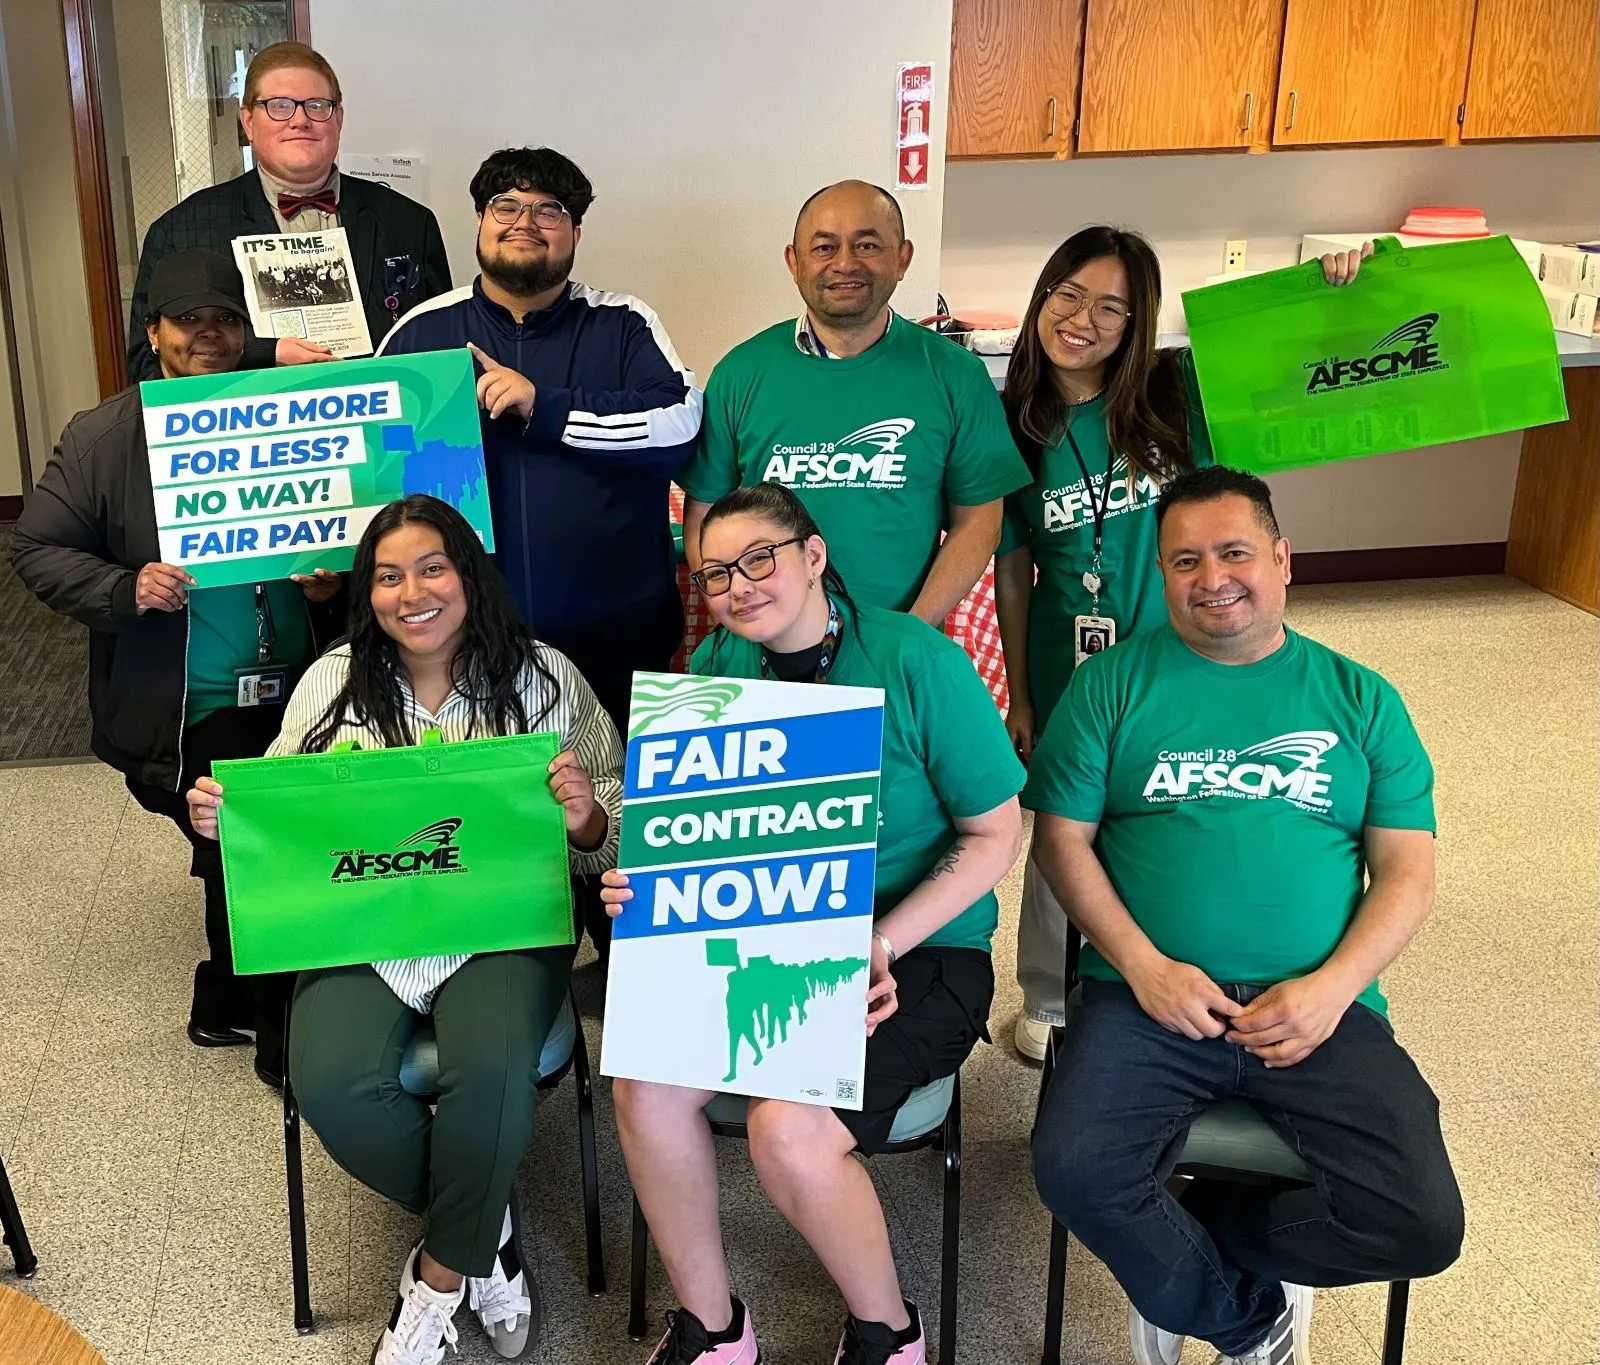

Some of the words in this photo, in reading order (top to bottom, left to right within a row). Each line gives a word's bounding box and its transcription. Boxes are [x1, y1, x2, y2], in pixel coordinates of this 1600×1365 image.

[904, 75, 928, 88] FIRE
[279, 236, 324, 250] TIME
[301, 246, 335, 255] bargain!
[1319, 383, 1356, 394] WASHINGTON
[1357, 375, 1391, 386] FEDERATION
[1400, 370, 1416, 378] STATE
[1417, 363, 1450, 374] EMPLOYEES
[164, 402, 278, 437] DOING
[288, 390, 388, 424] MORE
[170, 448, 240, 478] FOR
[250, 436, 350, 468] LESS?
[772, 443, 816, 454] Council
[820, 442, 835, 454] 28
[802, 481, 837, 489] Federation
[866, 482, 904, 490] Employees
[1042, 478, 1086, 500] Council
[175, 490, 227, 518] NO
[238, 478, 331, 509] WAY!
[1130, 503, 1148, 512] State
[180, 528, 259, 559] FAIR
[269, 516, 347, 548] PAY!
[637, 728, 788, 789] FAIR
[1158, 748, 1214, 762] Council
[1217, 749, 1237, 762] 28
[1146, 794, 1202, 804] Washington
[1198, 788, 1246, 800] Federation
[644, 794, 872, 847] CONTRACT
[342, 875, 379, 883] WASHINGTON
[380, 872, 412, 880] FEDERATION
[652, 860, 849, 926] NOW!
